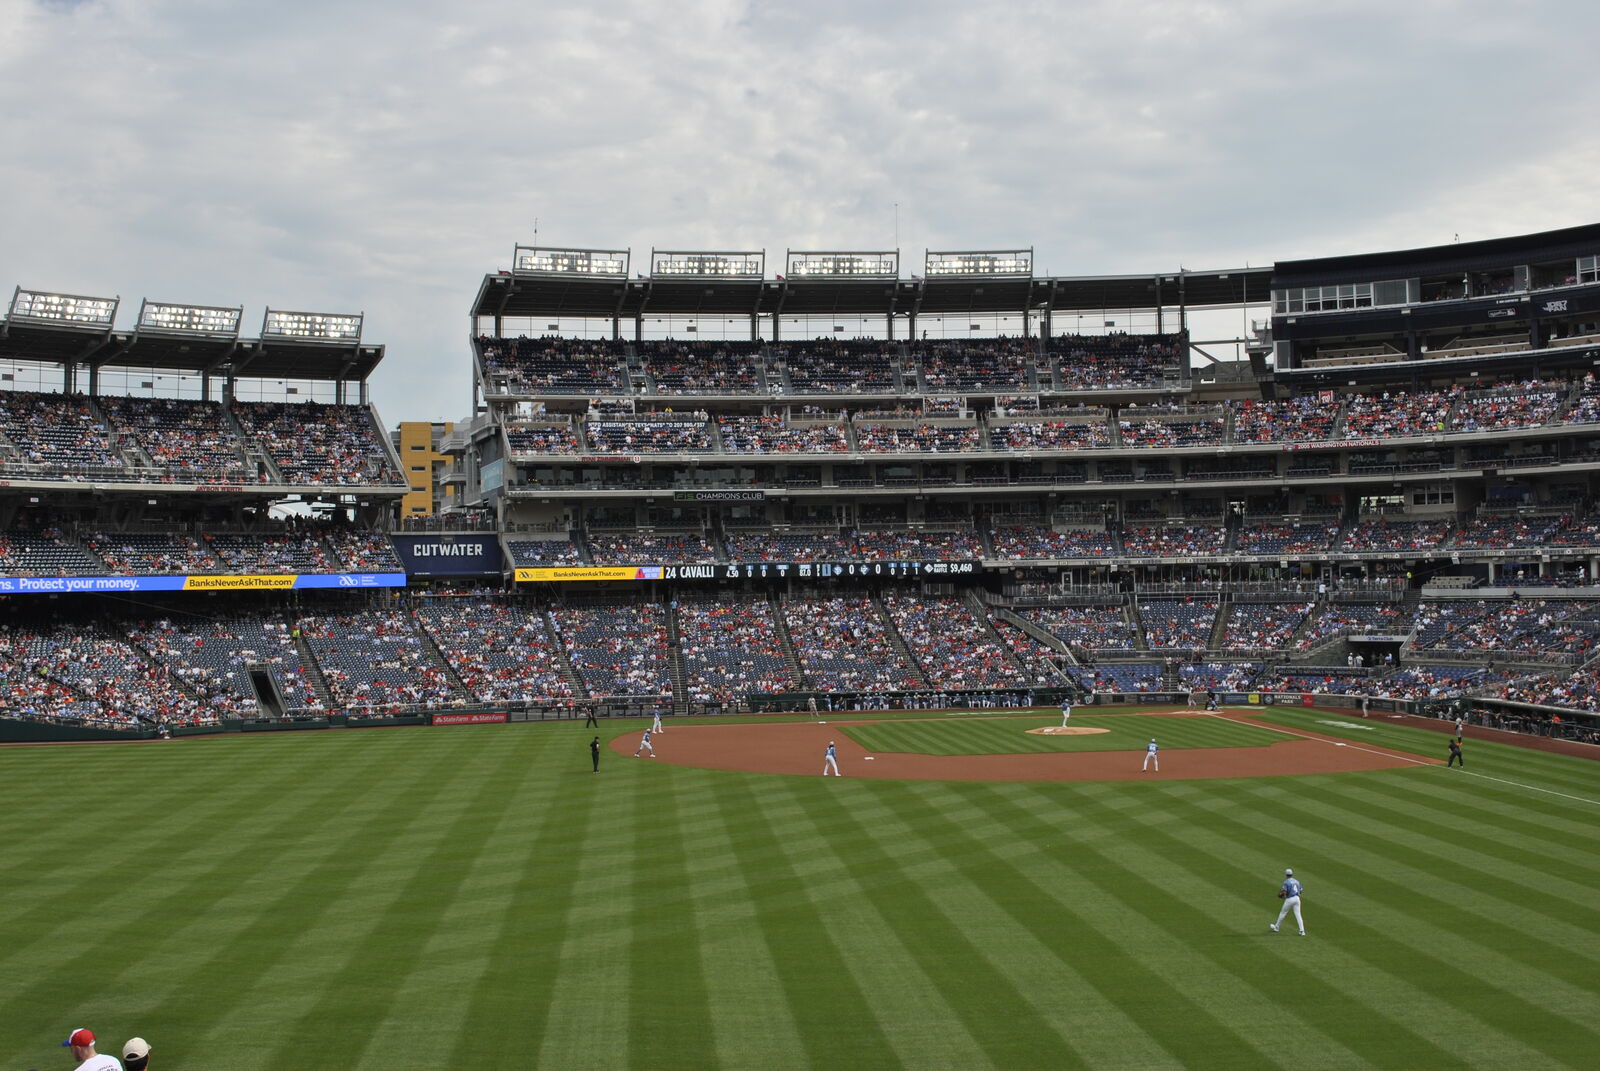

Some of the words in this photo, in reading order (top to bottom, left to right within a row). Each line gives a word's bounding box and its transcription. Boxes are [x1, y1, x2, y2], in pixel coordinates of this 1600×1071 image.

[696, 492, 740, 500] CHAMPIONS
[742, 492, 762, 500] CLUB
[413, 544, 483, 556] CUTWATER
[665, 567, 676, 579] 24
[680, 566, 714, 578] CAVALLI
[799, 568, 811, 576] 87.0
[849, 564, 854, 575] 0
[876, 564, 881, 575] 0
[890, 567, 895, 575] 0
[902, 567, 907, 575] 2
[915, 567, 919, 575] 1
[950, 563, 973, 573] $9,460
[726, 570, 739, 578] 4.50
[20, 579, 63, 590] Protect
[66, 580, 93, 592] your
[96, 579, 140, 590] money.
[189, 578, 292, 587] BanksNeverAskThat.com
